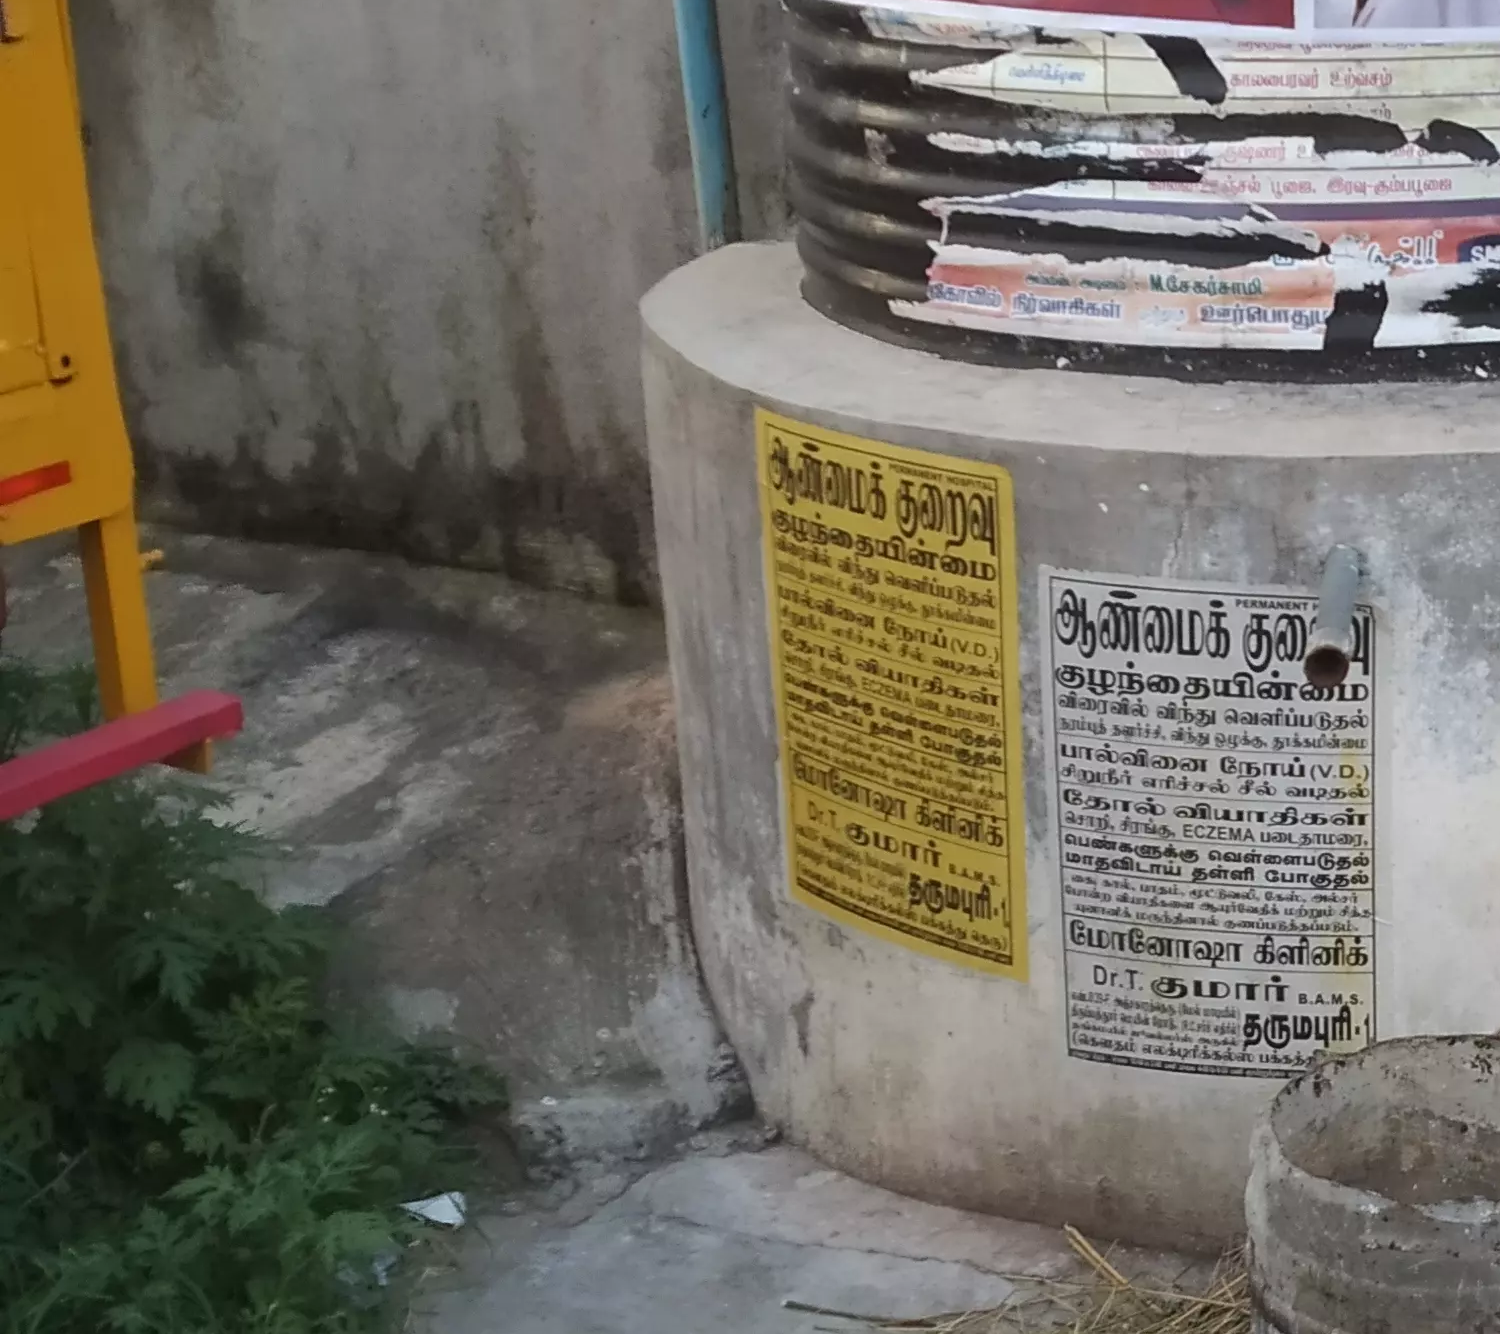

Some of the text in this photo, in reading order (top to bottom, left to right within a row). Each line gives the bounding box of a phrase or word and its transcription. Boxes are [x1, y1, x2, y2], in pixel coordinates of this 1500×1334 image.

[769, 436, 996, 556] ஆண்மைக் குறைவு
[772, 509, 996, 581] குழந்தையின்மை
[1055, 588, 1231, 658] ஆண்மைக்
[1235, 598, 1309, 611] PERMANENT
[855, 657, 999, 707] வியாதிகள்
[1055, 661, 1369, 701] குழந்தையின்மை
[1057, 694, 1369, 731] விரைவில் விந்து வெளிப்படுதல்
[1060, 743, 1369, 782] பால்வினை நோய் (V.D.)
[1061, 763, 1133, 786] சிறுநீர்
[1141, 775, 1230, 794] எரிச்சல்
[1285, 783, 1370, 800] வடிதல்
[1063, 788, 1368, 826] தோல் வியாதிகள்
[844, 822, 943, 868] குமார்
[1183, 823, 1255, 842] ECZEMA
[1064, 833, 1370, 871] பெண்களுக்கு வெள்ளைபடுதல்
[1066, 852, 1369, 889] மாதவிடாய் தள்ளி போகுதல்
[1070, 919, 1368, 968] மோனோஷா கிளினிக்
[1151, 975, 1290, 1001] குமார்
[1299, 993, 1364, 1006] B.A.M.S.
